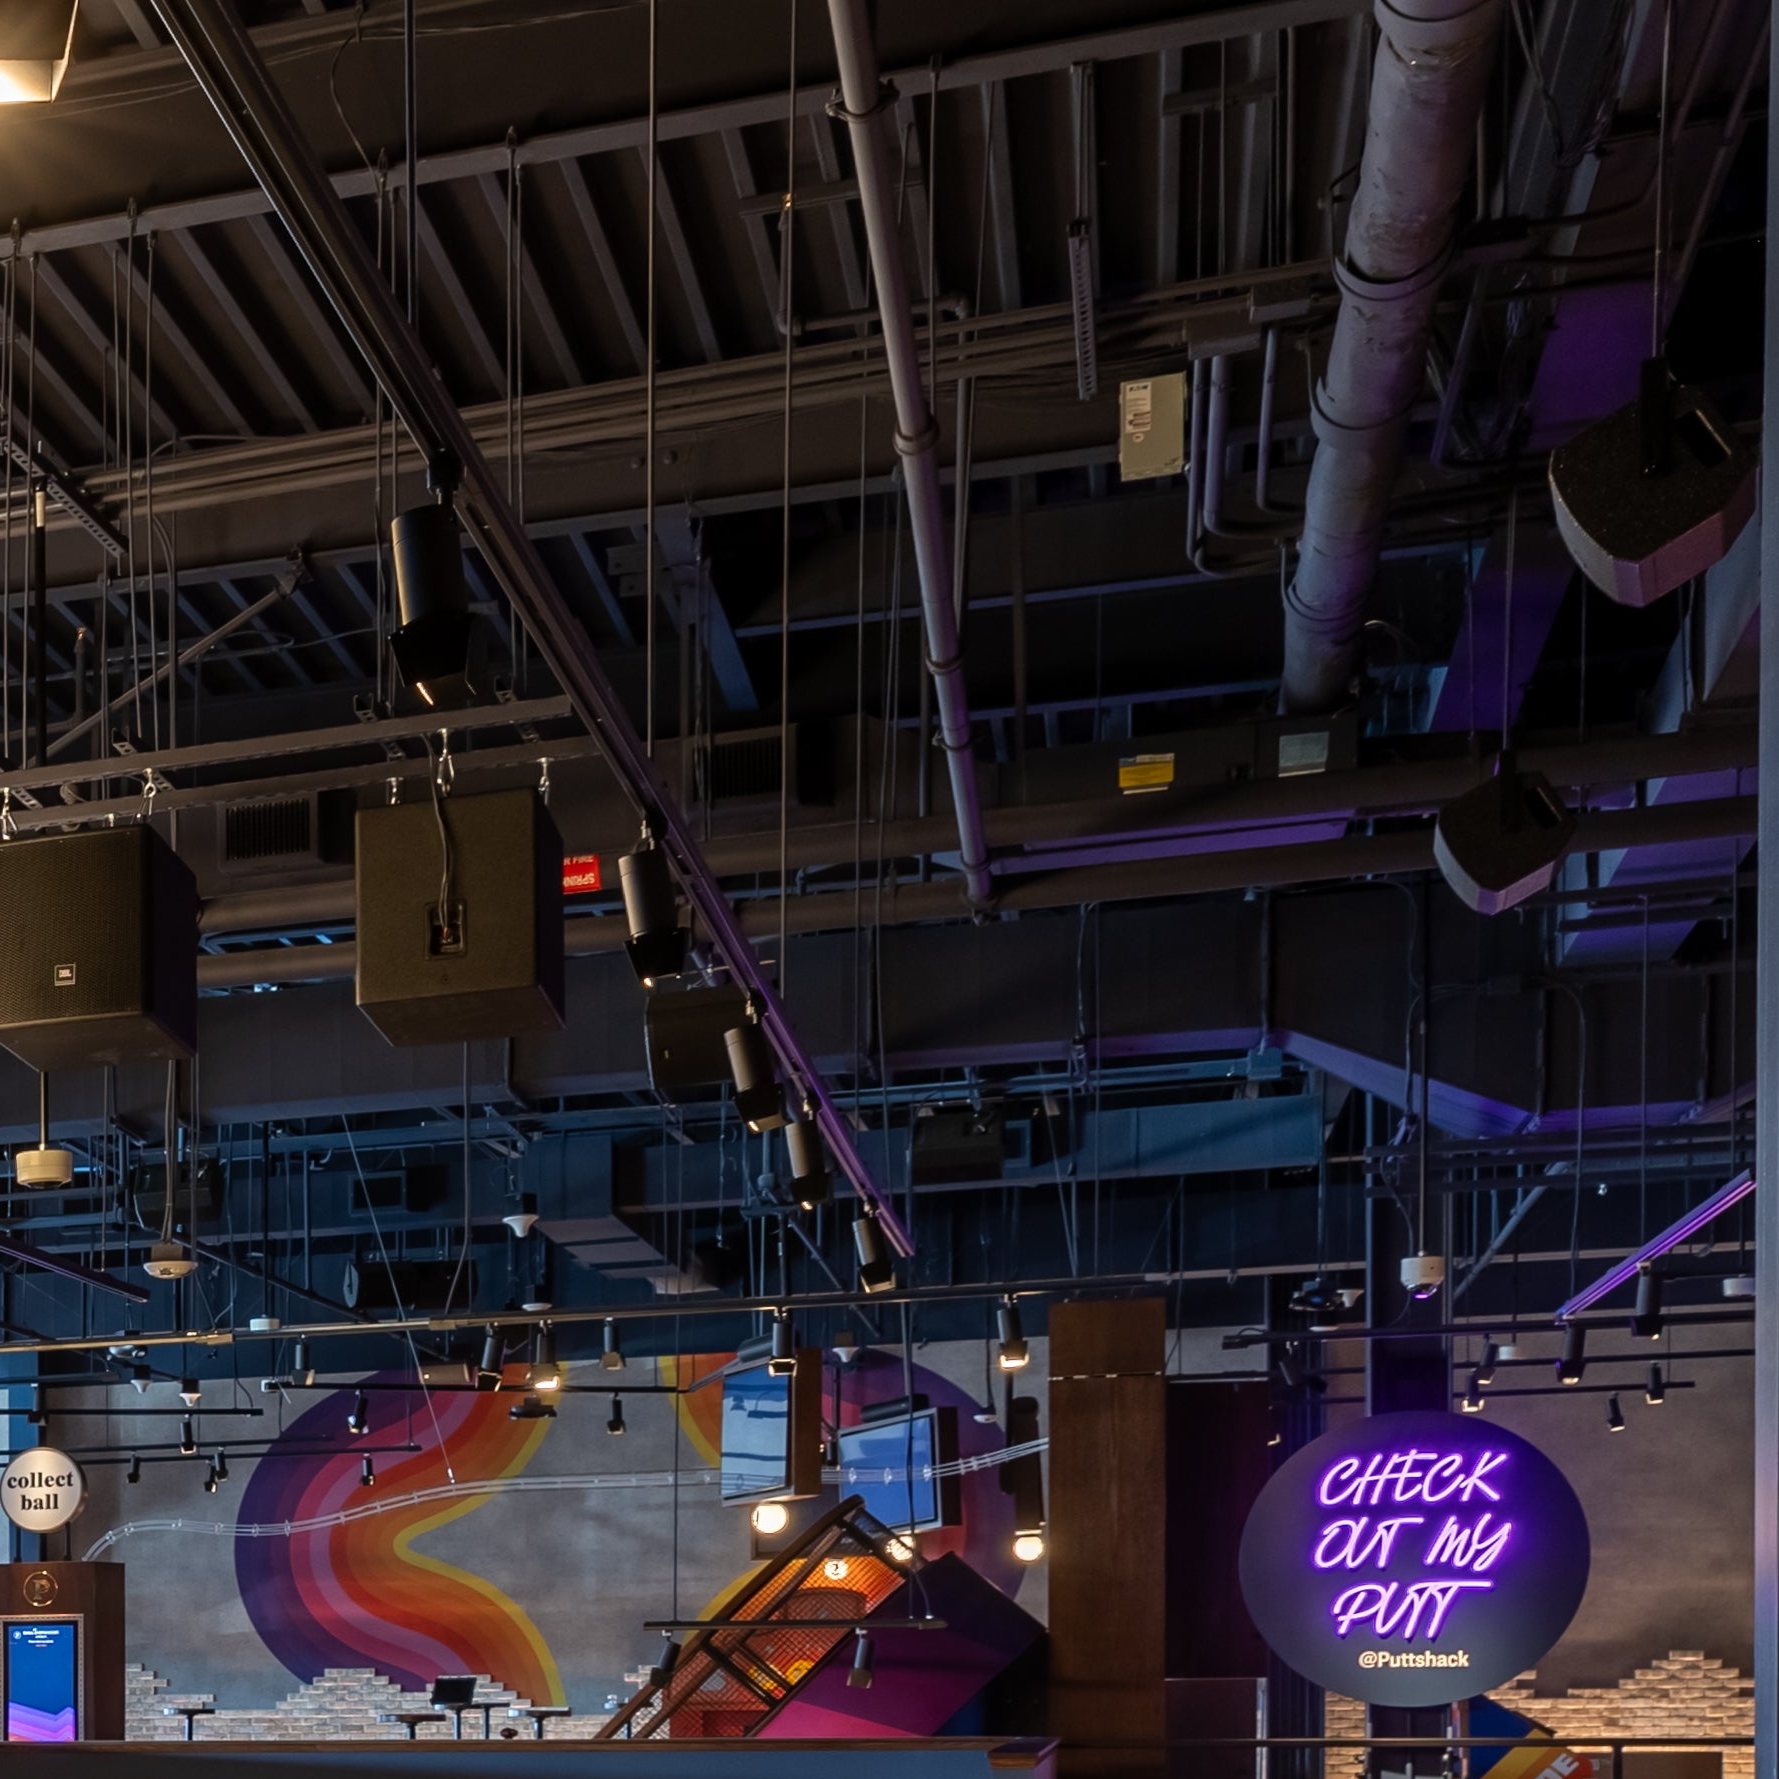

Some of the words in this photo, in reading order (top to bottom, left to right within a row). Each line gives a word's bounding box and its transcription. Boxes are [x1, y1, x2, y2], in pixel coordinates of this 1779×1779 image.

[7, 1472, 73, 1489] collect
[1318, 1449, 1507, 1506] CHECK
[21, 1494, 59, 1510] ball
[1314, 1516, 1424, 1568] OUT
[1332, 1580, 1493, 1640] PUTT
[1358, 1650, 1469, 1669] @Puttshack
